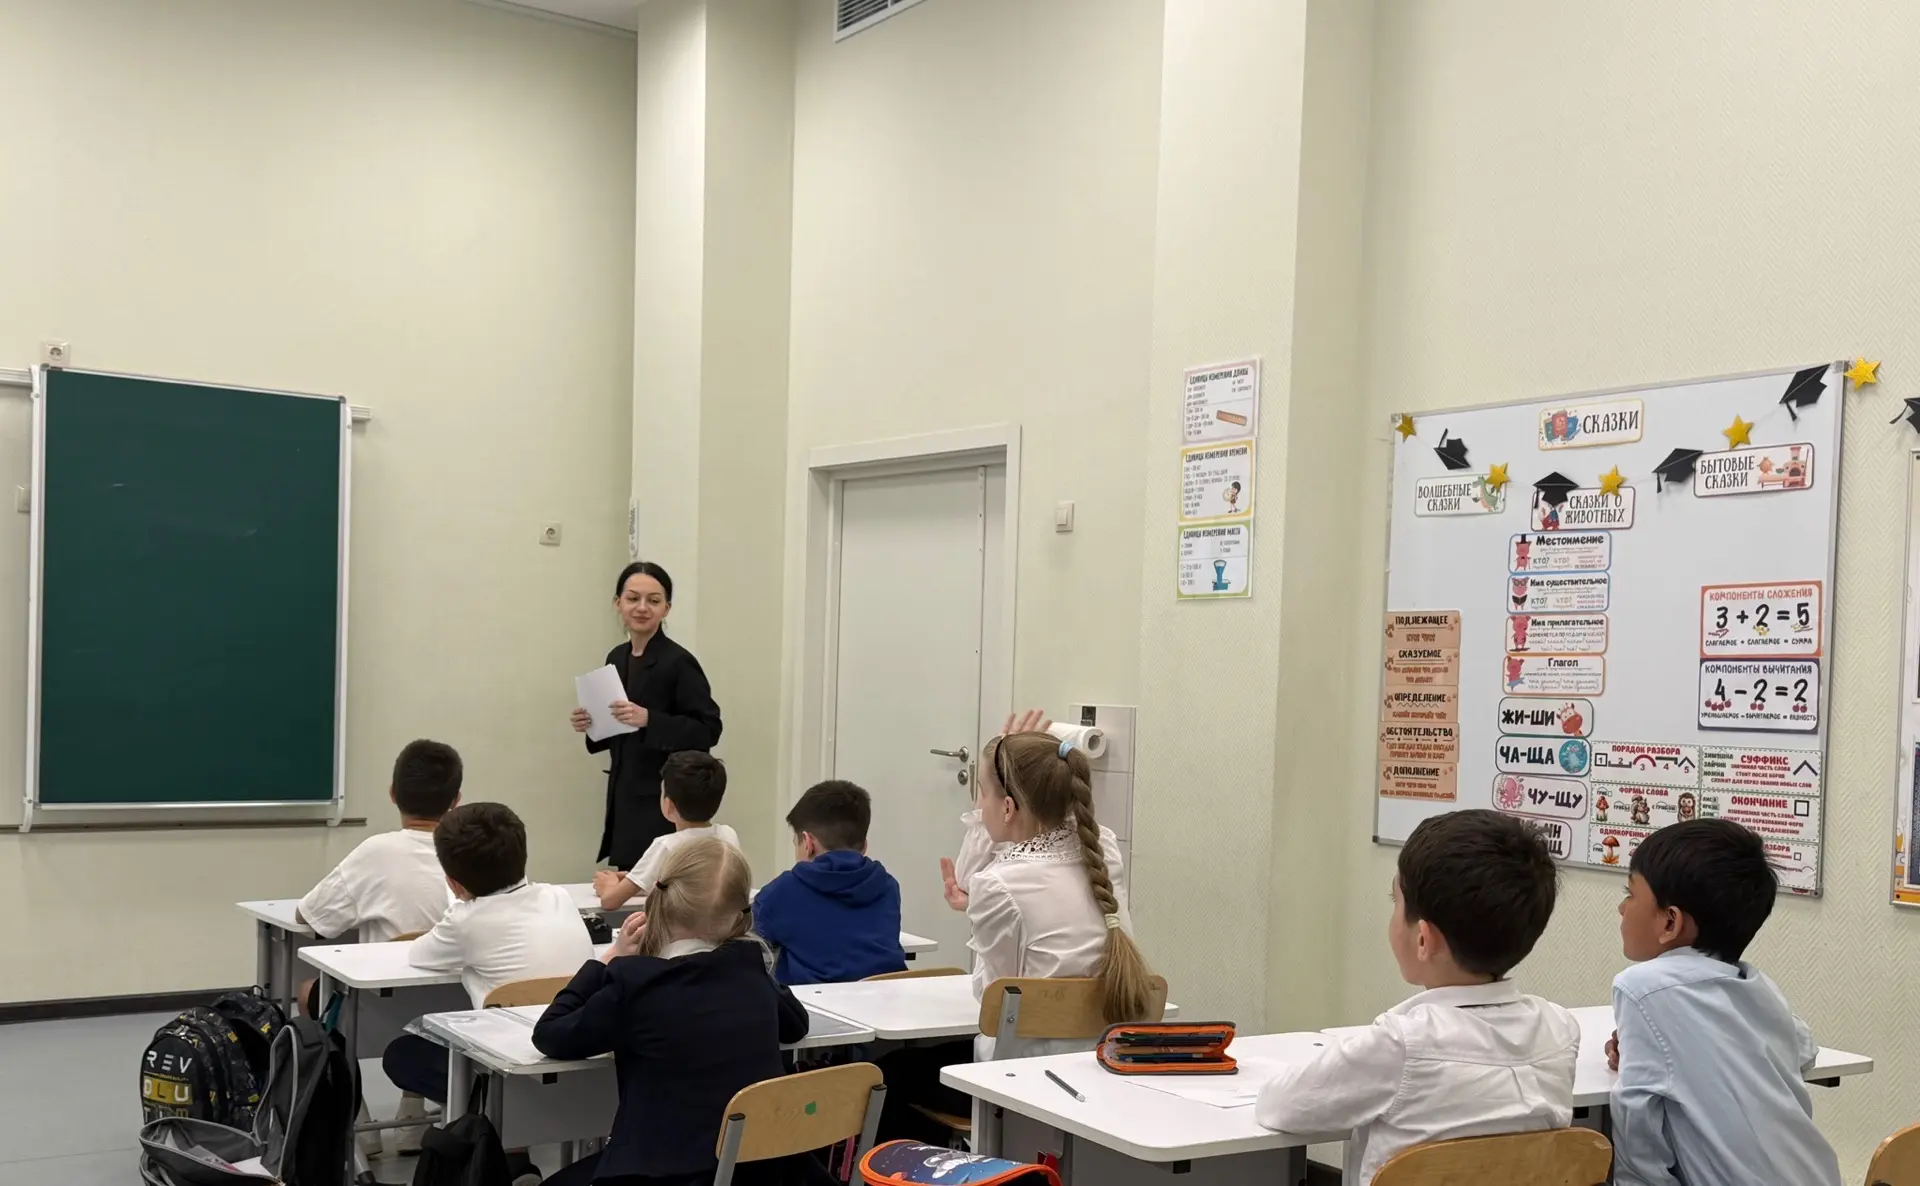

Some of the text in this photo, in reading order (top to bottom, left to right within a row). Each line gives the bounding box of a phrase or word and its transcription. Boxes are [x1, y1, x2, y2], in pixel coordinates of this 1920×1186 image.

[1583, 410, 1639, 434] СКАЗКИ
[1700, 456, 1755, 474] БЫТОВЫЕ
[1705, 472, 1748, 489] СКАЗКИ
[1418, 483, 1472, 499] ВОЛШЕБНЫЕ
[1427, 498, 1461, 512] СКАЗКИ
[1569, 494, 1622, 510] СКАЗКИ О
[1564, 508, 1626, 524] ЖИВОТНЫХ
[1536, 535, 1604, 546] Местоимение
[1530, 578, 1607, 588] Имя существительное
[1709, 588, 1813, 601] КОМПОНЕНТЫ СЛОЖЕНИЯ
[1395, 615, 1448, 626] ПОДЛЕЖАЩЕЕ
[1716, 606, 1728, 628] 3
[1756, 604, 1769, 628] 2
[1797, 602, 1809, 626] 5
[1531, 618, 1604, 629] Имя прилагательное
[1747, 638, 1780, 646] СЛАГАЕМОЕ
[1792, 637, 1813, 645] СУММА
[1398, 649, 1442, 658] СКАЗУЕМОЕ
[1547, 658, 1579, 667] Глагол
[1705, 664, 1813, 675] КОМПОНЕНТЫ ВЫЧИТАНИЯ
[1714, 678, 1726, 702] 4
[1753, 679, 1768, 703] 2
[1794, 679, 1808, 703] 2
[1394, 693, 1446, 703] ОПРЕДЕЛЕНИЕ
[1501, 709, 1555, 726] ЖИ-ШИ
[1386, 727, 1453, 737] ОБСТОЯТЕЛЬСТВО
[1500, 745, 1555, 765] ЧА-ЩА
[1612, 745, 1680, 755] ПОРЯДОК РАЗБОРА
[1703, 760, 1727, 768] ЗАЙЧИК
[1740, 754, 1789, 765] СУФФИКС
[1393, 766, 1440, 777] ДОПОЛНЕНИЕ
[1684, 766, 1690, 774] 5
[1619, 787, 1669, 796] ФОРМЫ СЛОВА
[1528, 788, 1583, 809] ЧУ-ЩУ
[1731, 796, 1788, 809] ОКОНЧАНИЕ
[1752, 818, 1788, 826] ОБРАЗОВАНИЯ
[1763, 843, 1791, 852] АЗБОРА
[146, 1050, 193, 1074] REV
